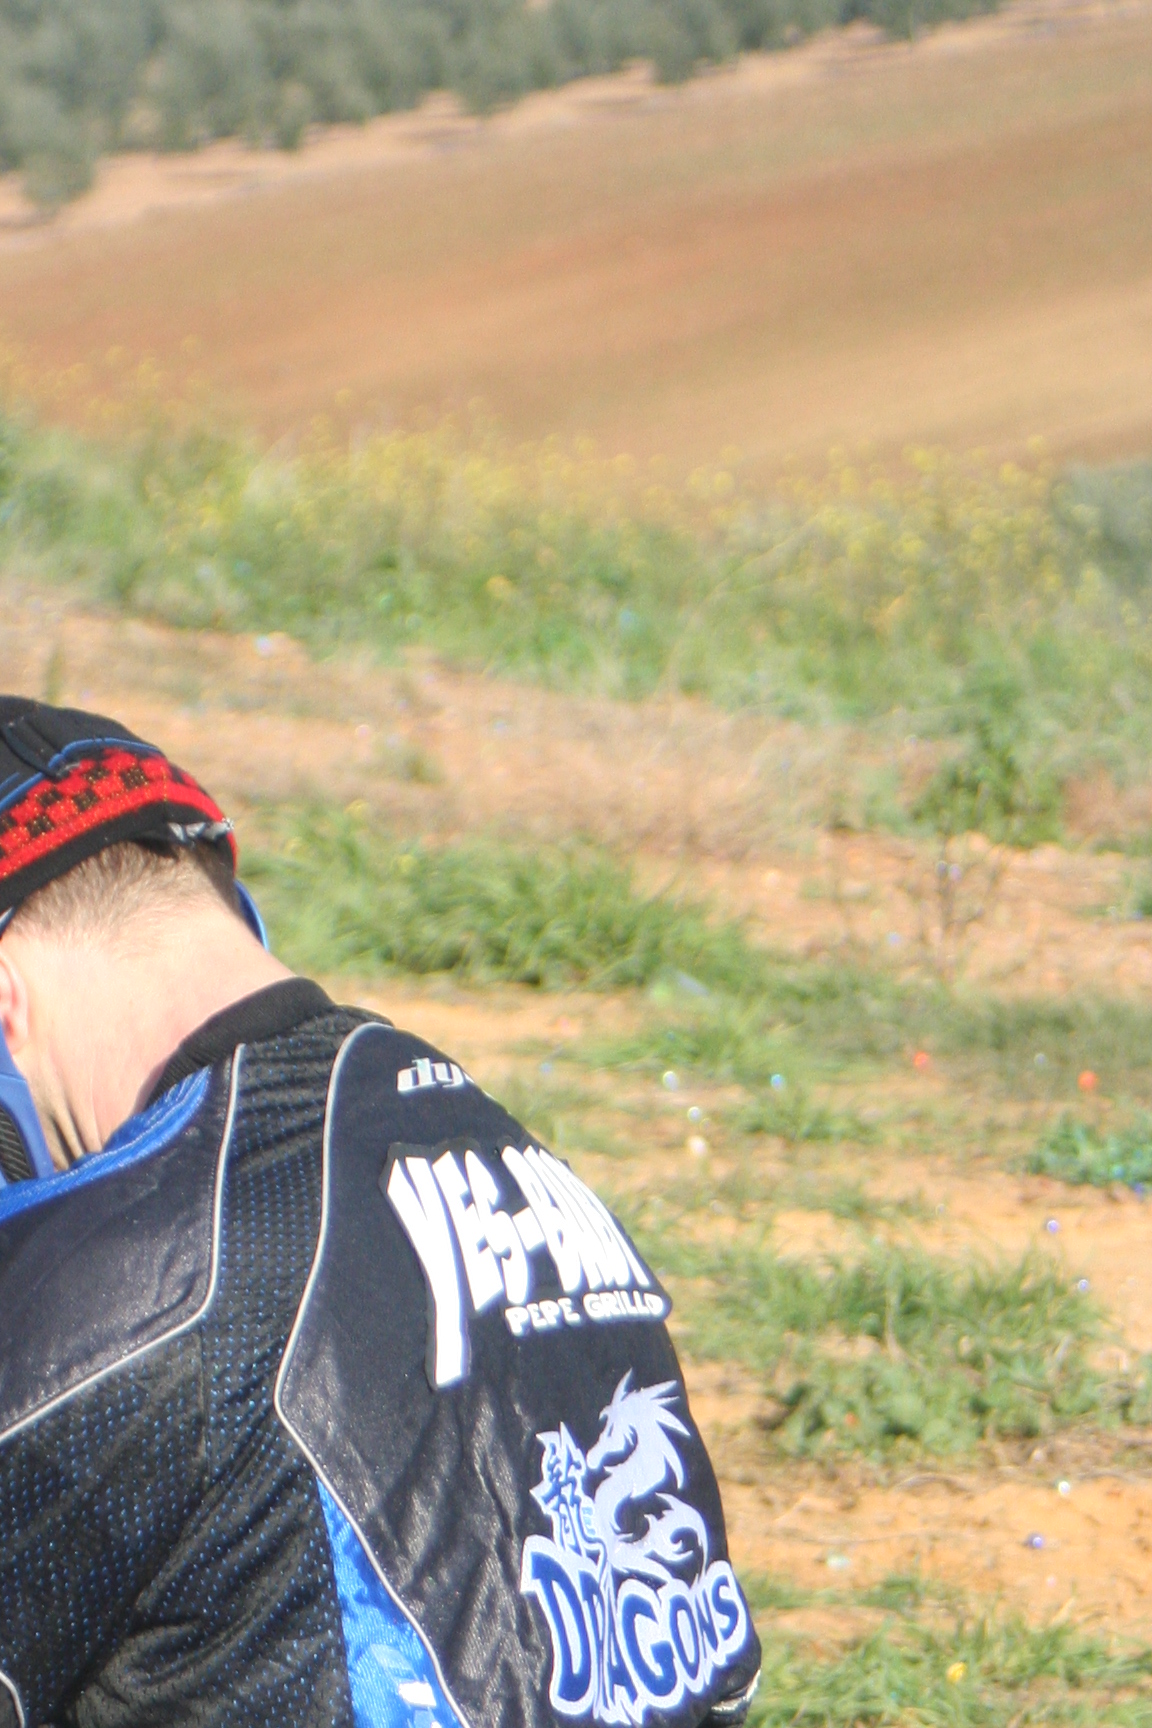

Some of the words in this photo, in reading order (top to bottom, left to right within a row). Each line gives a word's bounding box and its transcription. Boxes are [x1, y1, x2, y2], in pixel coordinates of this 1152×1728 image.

[397, 1057, 476, 1093] dy
[504, 1297, 581, 1336] PEPE
[583, 1289, 666, 1322] GRILLO
[524, 1540, 744, 1720] DRAGONS
